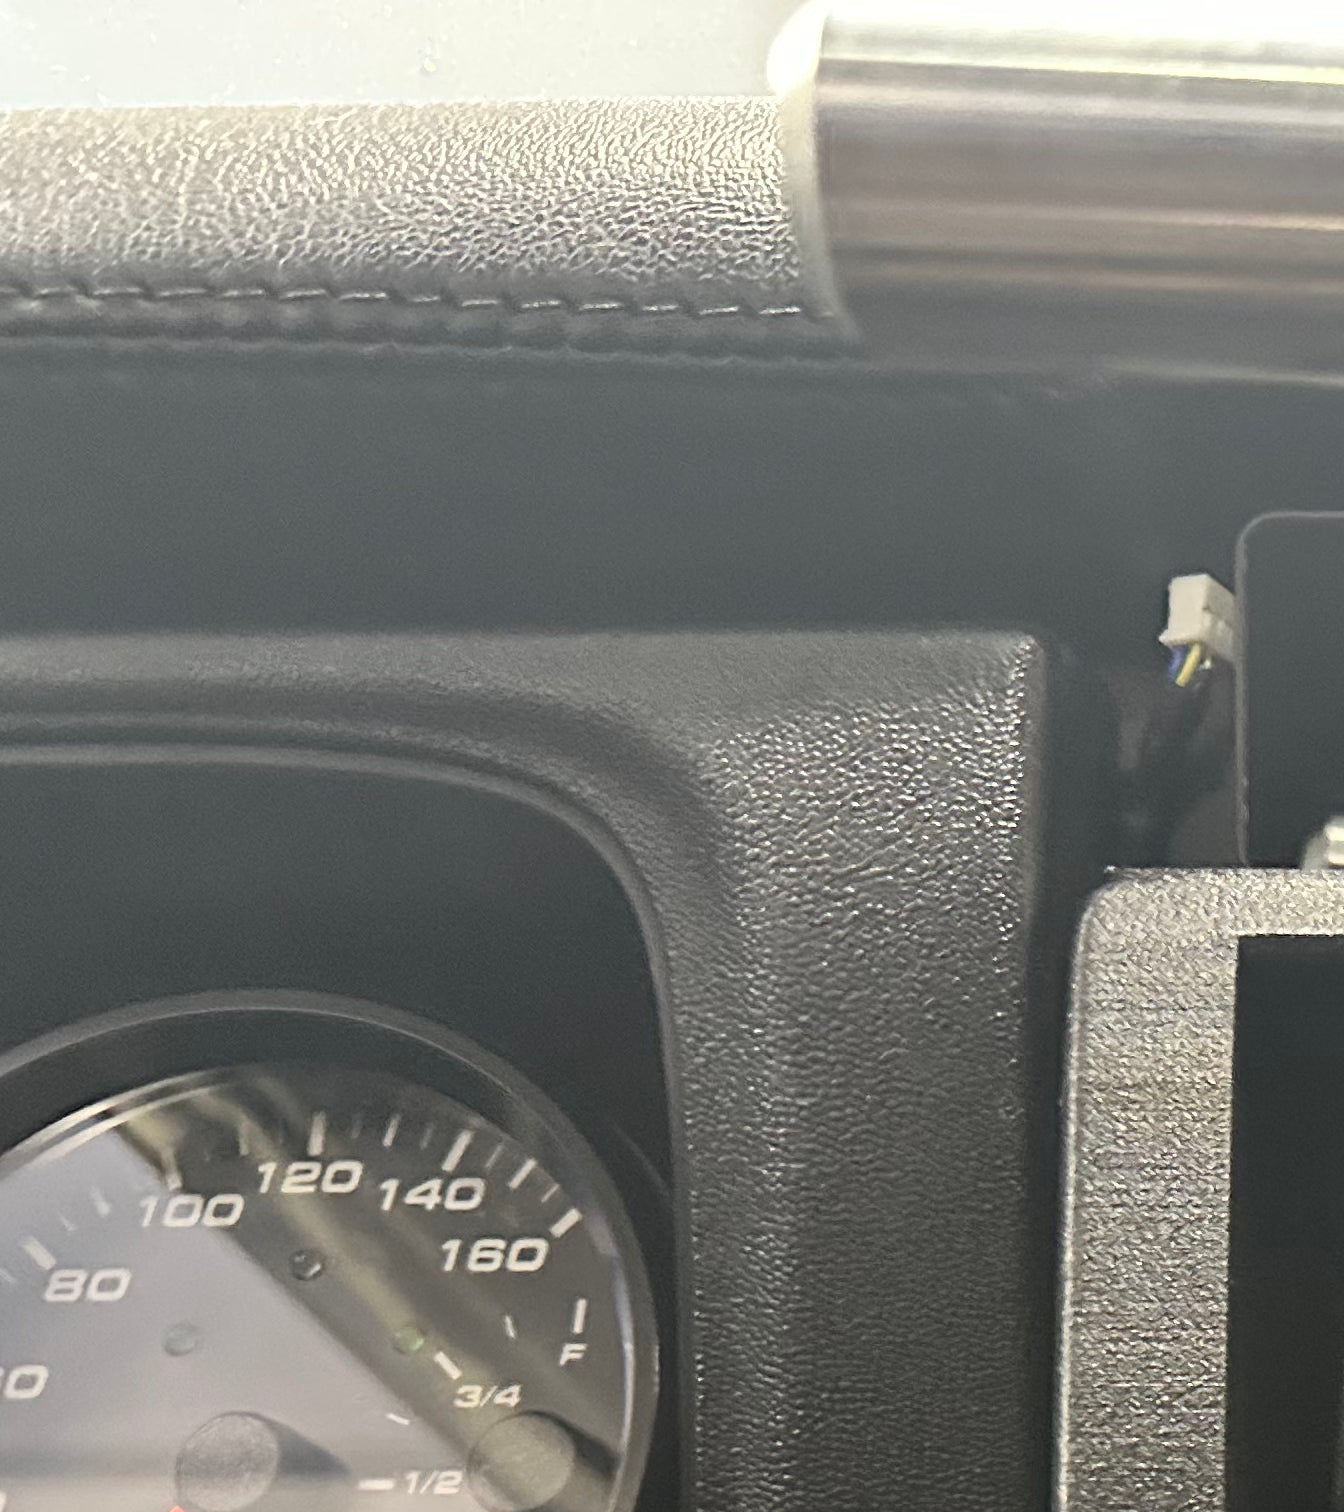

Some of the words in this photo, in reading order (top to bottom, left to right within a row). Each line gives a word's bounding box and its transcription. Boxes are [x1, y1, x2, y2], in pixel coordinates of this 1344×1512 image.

[256, 1160, 364, 1194] 120
[378, 1177, 487, 1211] 140
[138, 1194, 246, 1228] 100
[440, 1237, 549, 1272] 160
[44, 1268, 132, 1302] 80
[560, 1343, 587, 1367] F
[0, 1364, 49, 1399] 0
[453, 1384, 521, 1408] 3/4
[403, 1470, 464, 1494] 1/2
